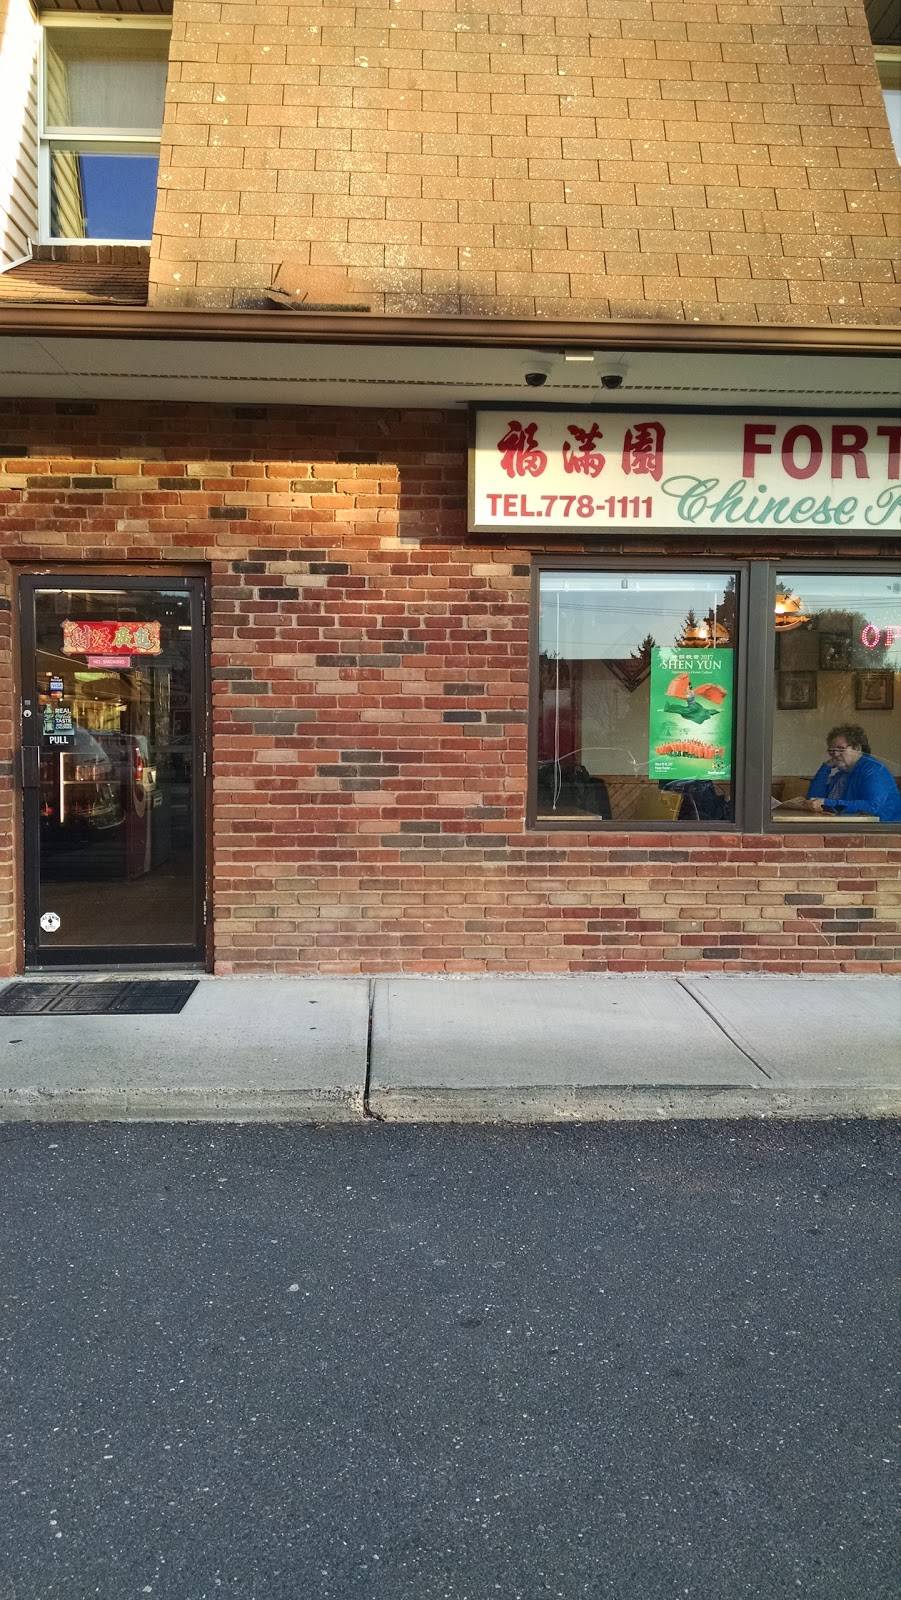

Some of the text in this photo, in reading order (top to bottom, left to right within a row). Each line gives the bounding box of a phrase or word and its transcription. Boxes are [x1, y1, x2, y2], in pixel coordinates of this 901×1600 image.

[742, 424, 901, 480] FORT
[486, 493, 653, 518] TEL.778-1111
[661, 475, 858, 525] Chinese
[662, 660, 722, 669] SHEN YUN
[49, 735, 69, 744] PULL
